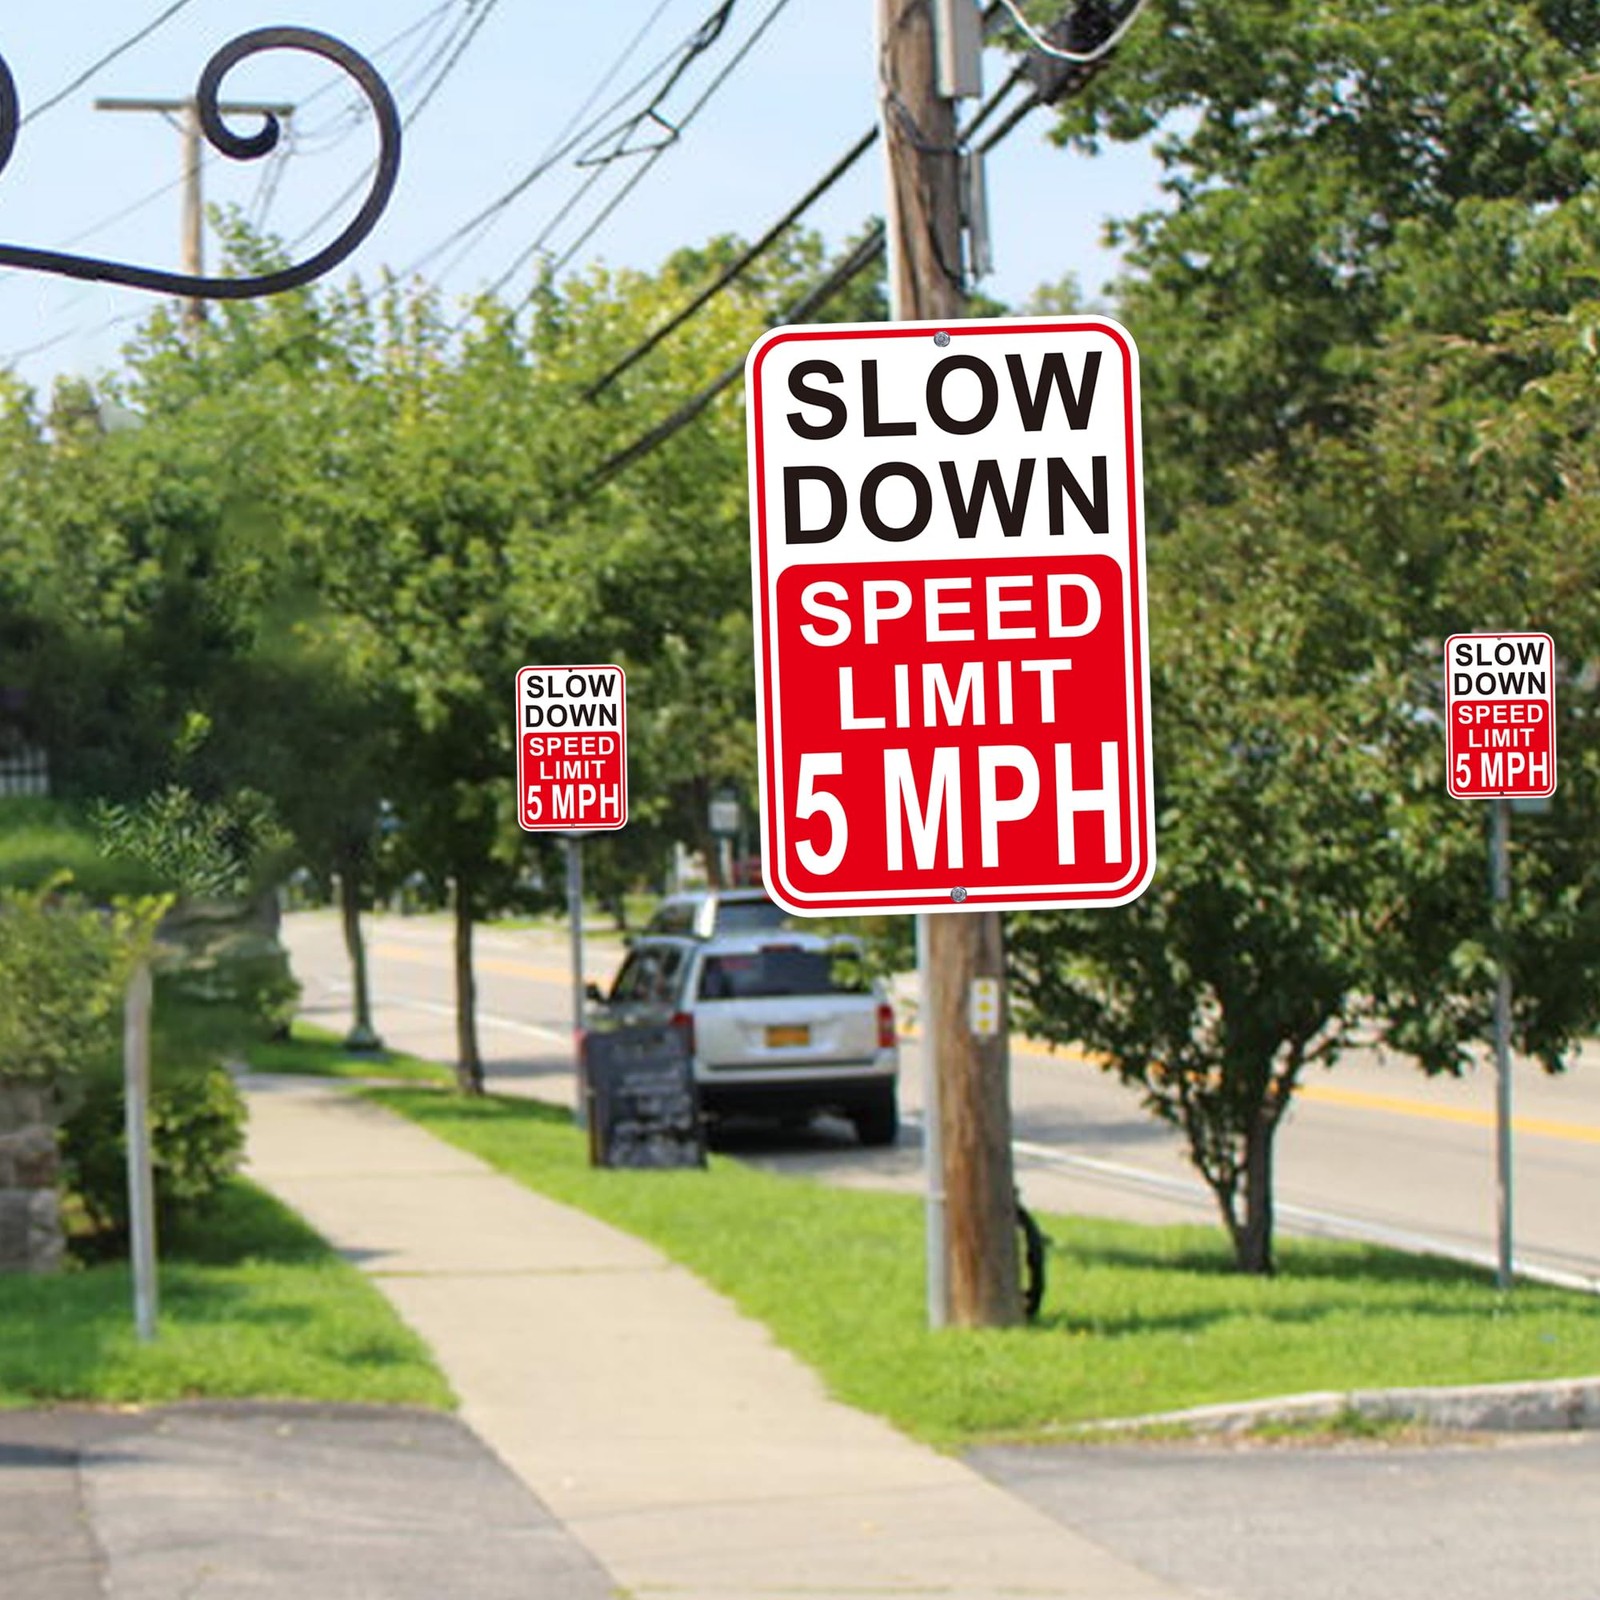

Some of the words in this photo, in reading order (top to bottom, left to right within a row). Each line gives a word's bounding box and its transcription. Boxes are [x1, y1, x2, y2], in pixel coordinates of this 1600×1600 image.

[786, 350, 1103, 440] SLOW
[782, 455, 1110, 545] DOWN
[799, 573, 1102, 647] SPEED
[1455, 642, 1545, 667] SLOW
[526, 674, 616, 699] SLOW
[838, 658, 1073, 731] LIMIT
[1454, 671, 1546, 696] DOWN
[525, 703, 617, 728] DOWN
[1458, 704, 1543, 724] SPEED
[529, 736, 615, 756] SPEED
[1468, 727, 1535, 748] LIMIT
[539, 760, 606, 780] LIMIT
[1455, 753, 1471, 788] 5
[1480, 751, 1548, 788] MPH
[526, 785, 543, 820] 5
[551, 783, 619, 820] MPH
[794, 751, 849, 876] 5
[882, 740, 1123, 872] MPH
